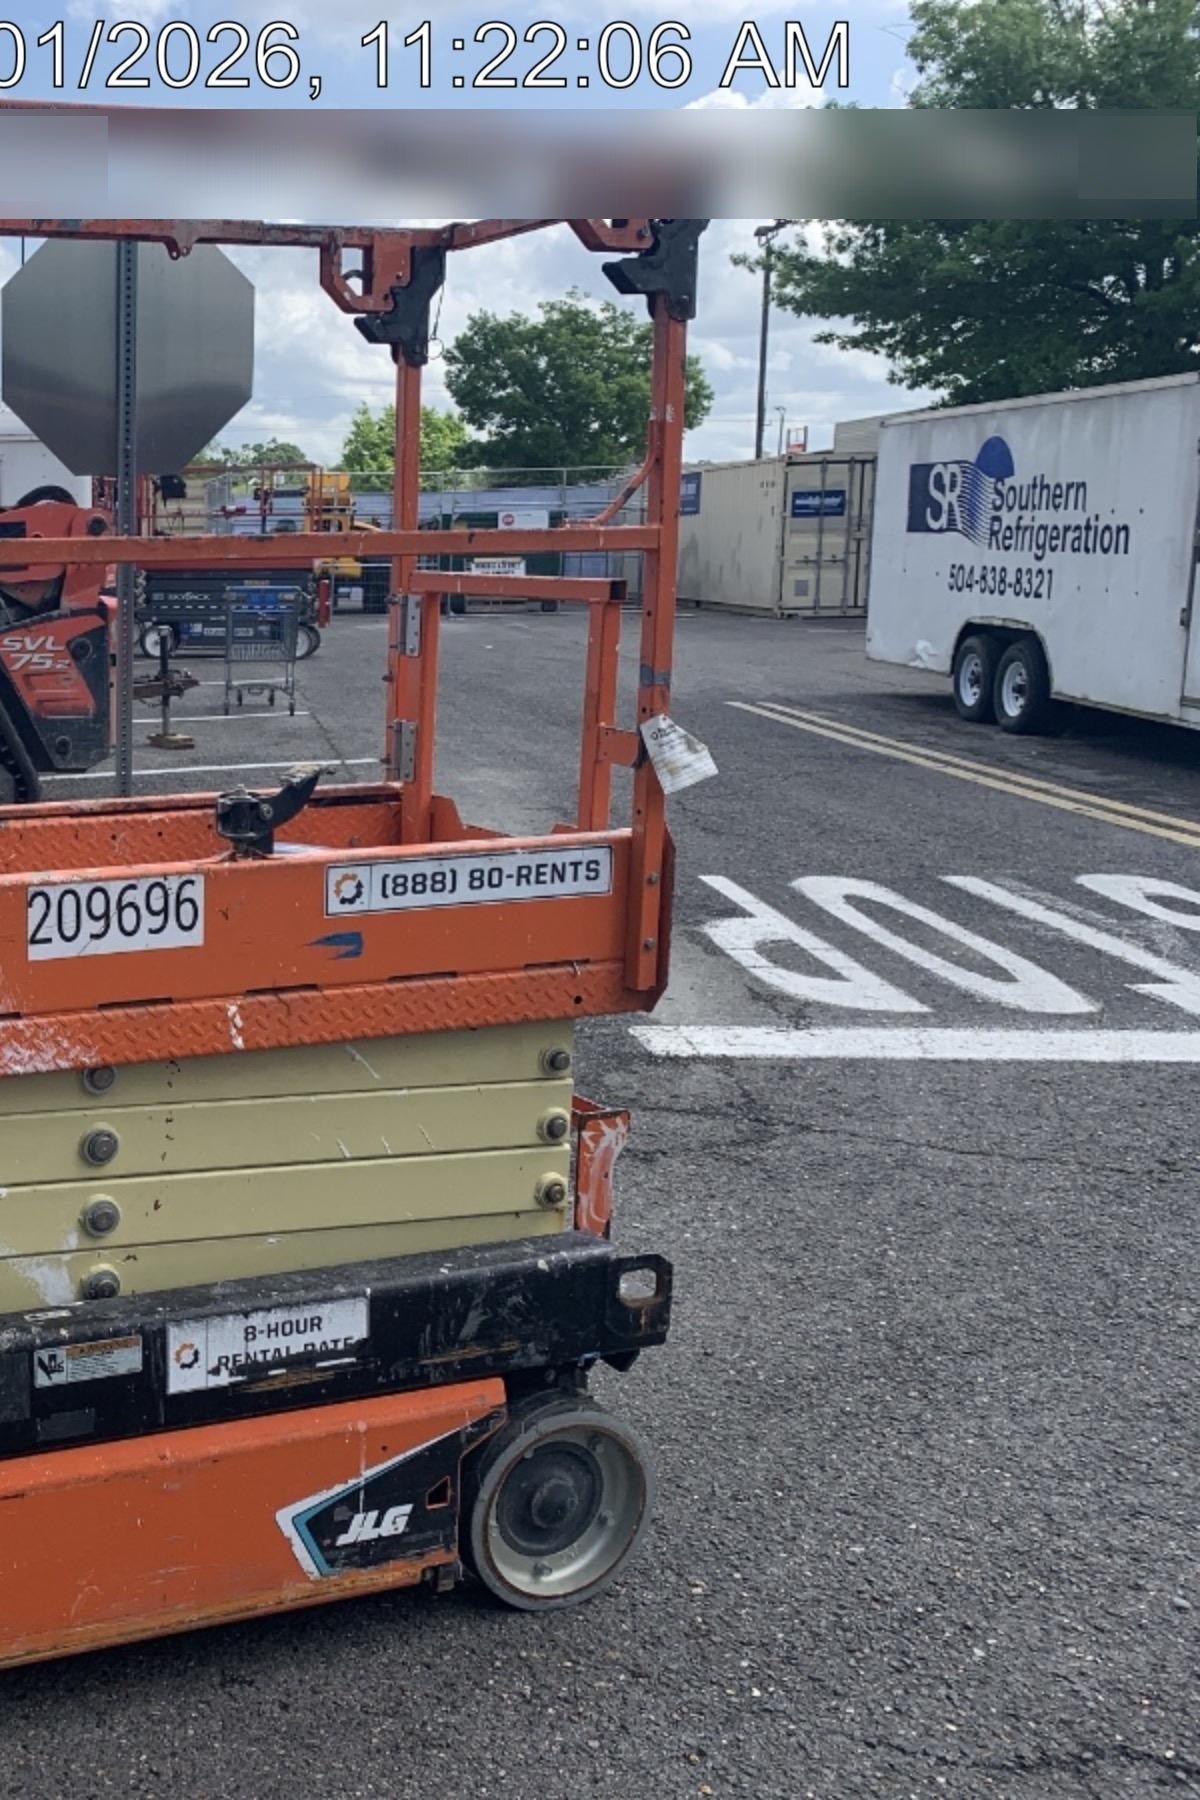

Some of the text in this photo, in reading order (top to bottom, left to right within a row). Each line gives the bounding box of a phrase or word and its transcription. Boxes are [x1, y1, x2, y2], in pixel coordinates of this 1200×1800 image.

[926, 463, 963, 531] SR
[992, 474, 1087, 513] Southern
[988, 514, 1131, 561] Refrigeration
[948, 564, 1053, 600] 504-838-8321
[0, 635, 65, 652] SVL
[381, 859, 601, 899] (888) 80-RENTS
[28, 879, 199, 945] 209696
[243, 1315, 323, 1343] 8-HOUR
[336, 1503, 414, 1546] JLG
